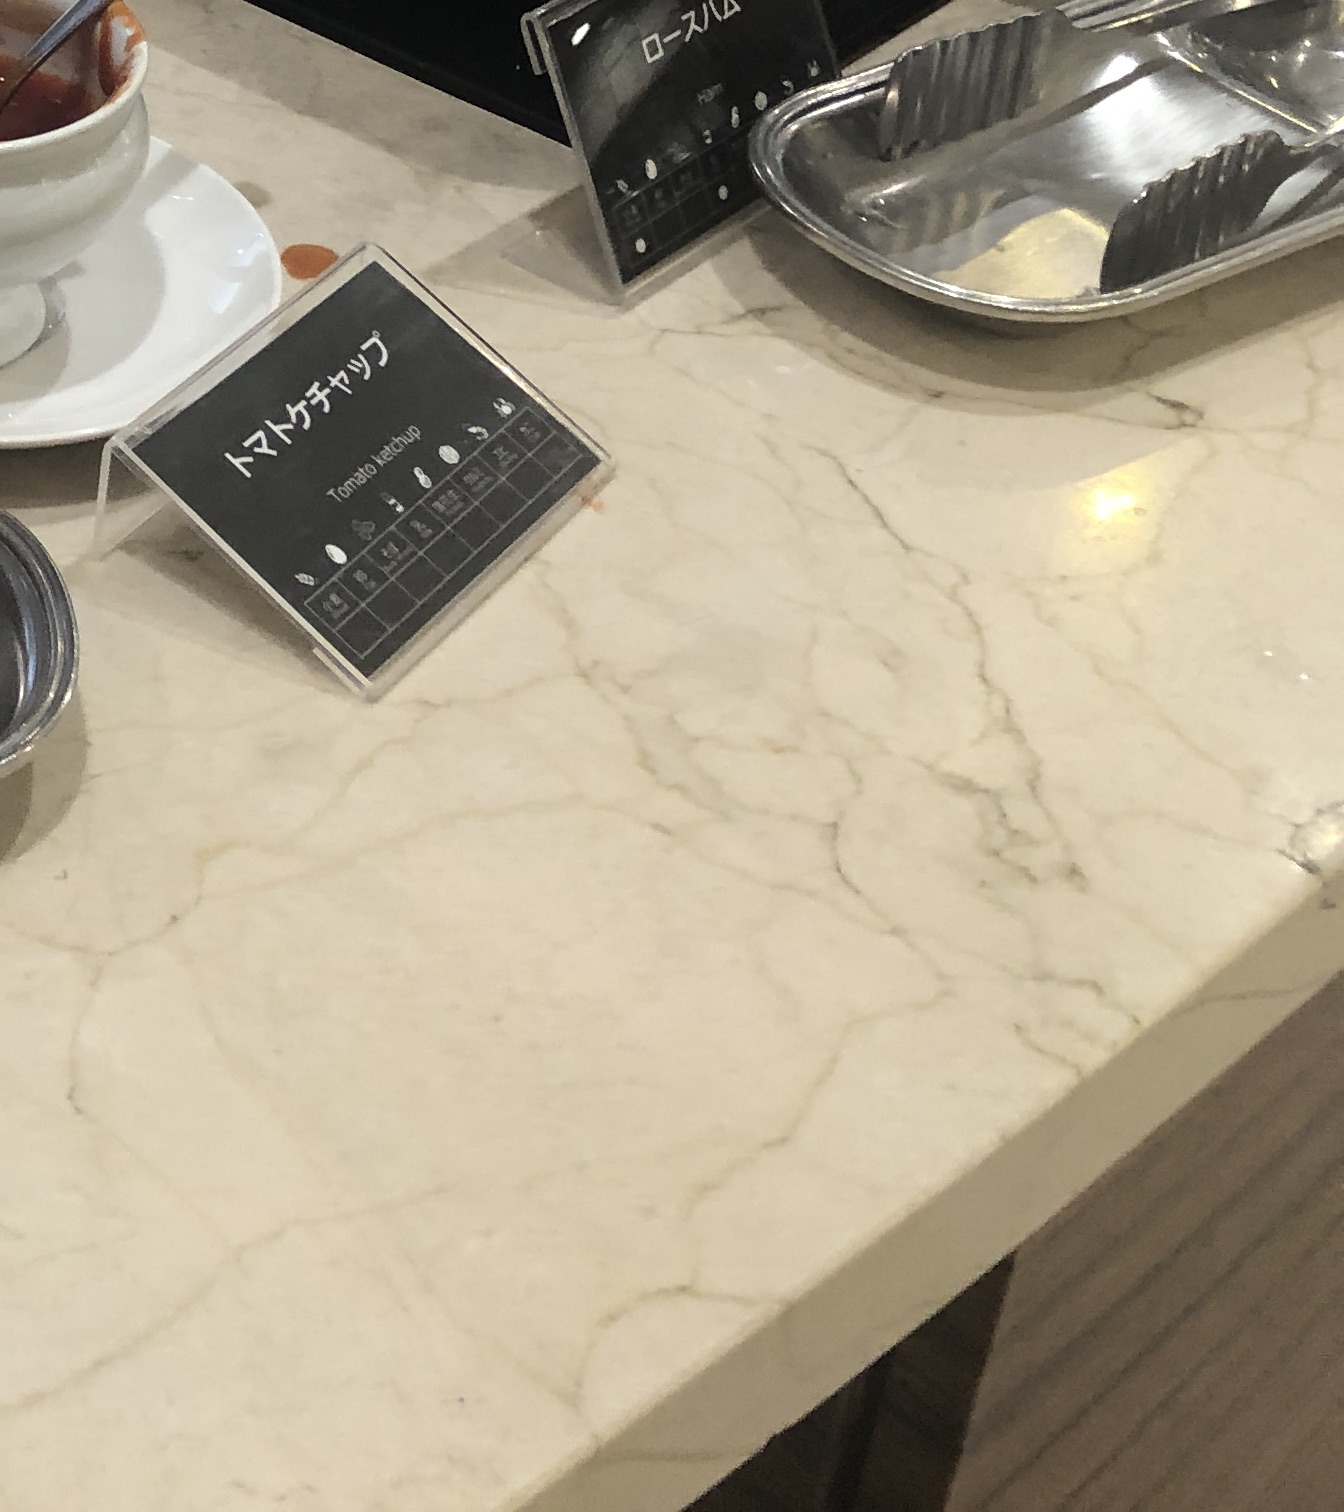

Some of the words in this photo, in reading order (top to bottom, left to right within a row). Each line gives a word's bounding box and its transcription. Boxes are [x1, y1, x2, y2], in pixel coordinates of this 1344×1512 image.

[223, 329, 390, 479] トマトケチャップ
[326, 460, 376, 506] Tomato
[371, 424, 422, 474] ketchup
